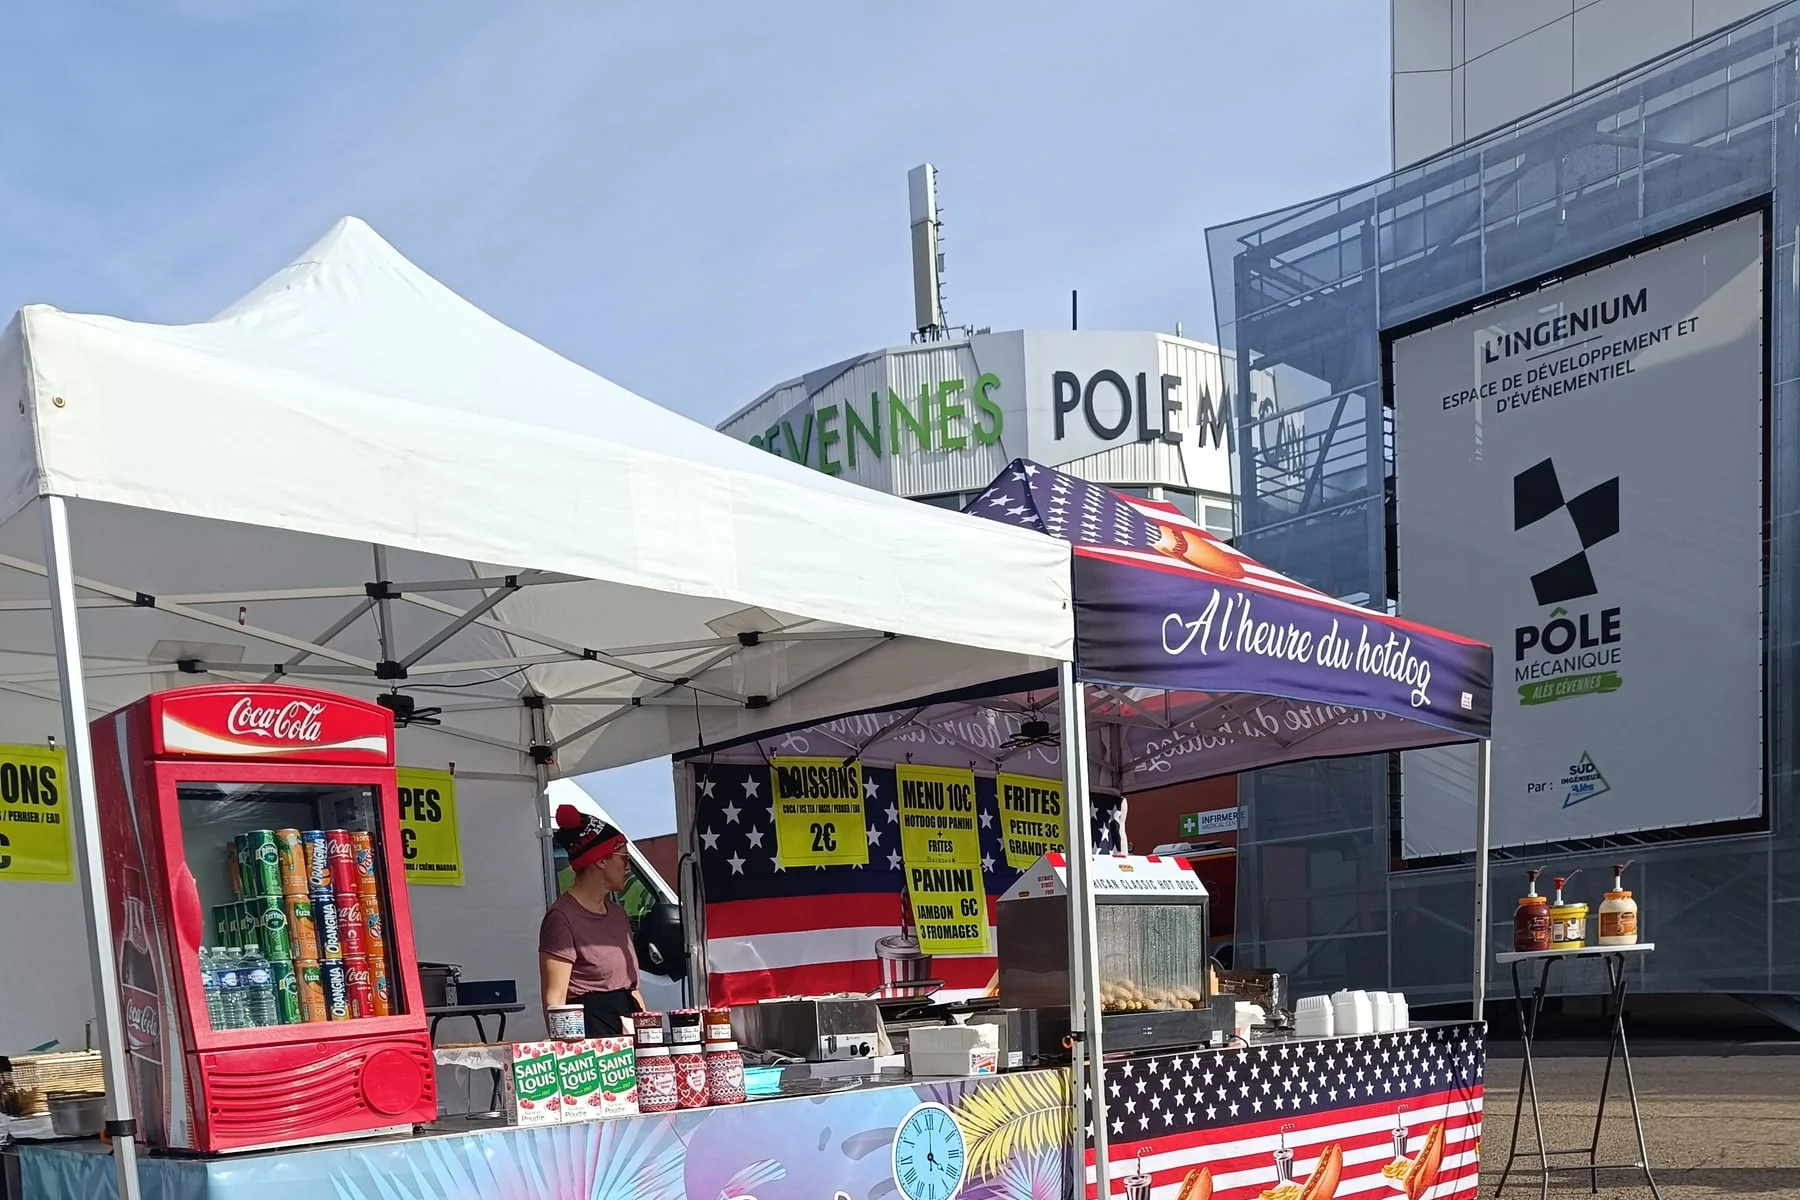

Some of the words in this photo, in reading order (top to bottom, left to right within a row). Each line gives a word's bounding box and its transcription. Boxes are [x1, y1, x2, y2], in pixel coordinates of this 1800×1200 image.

[1485, 288, 1649, 364] L'INGENIUM
[1442, 382, 1497, 411] ESPACE
[1502, 374, 1523, 391] DE
[1527, 325, 1672, 386] DÉVELOPPEMENT
[1678, 316, 1699, 337] ET
[1497, 358, 1636, 413] D'ÉVÉNEMENTIEL
[1053, 368, 1183, 444] POLE
[1515, 606, 1621, 661] PÔLE
[1162, 588, 1221, 656] A
[1219, 593, 1314, 663] l'heure
[1317, 618, 1354, 670] du
[1356, 624, 1432, 707] hotdog
[1515, 648, 1622, 681] MÉCANIQUE
[227, 697, 327, 741] Coca-Cola
[1569, 763, 1596, 775] SUD
[902, 780, 945, 811] MENU
[947, 783, 973, 812] 10€
[1527, 780, 1547, 793] Par
[1003, 784, 1061, 816] FRITES
[8, 810, 40, 823] PERRIER
[46, 812, 60, 824] EAU
[904, 814, 936, 829] HOTDOG
[936, 816, 947, 829] OU
[948, 817, 973, 830] PANINI
[1201, 811, 1246, 825] INFIRMERE
[810, 822, 837, 852] 2€
[1010, 819, 1043, 838] PETITE
[1045, 823, 1060, 839] 3€
[928, 839, 953, 853] FRITES
[1009, 839, 1047, 857] GRANDE
[310, 838, 326, 886] ORANGINA
[911, 868, 975, 892] PANINI
[1120, 880, 1158, 890] CLASSIC
[960, 898, 979, 916] 6€
[323, 903, 340, 954] ORANGINA
[920, 925, 926, 939] 3
[927, 924, 979, 939] FROMAGES
[329, 967, 346, 1017] ORANGINA
[516, 1060, 554, 1078] SAINT
[559, 1056, 595, 1075] SAINT
[598, 1053, 633, 1072] SAINT
[519, 1072, 556, 1093] LOUIS
[562, 1069, 597, 1090] LOUIS
[602, 1066, 636, 1086] LOUIS
[522, 1114, 545, 1122] Poudre
[565, 1111, 588, 1119] Poudre
